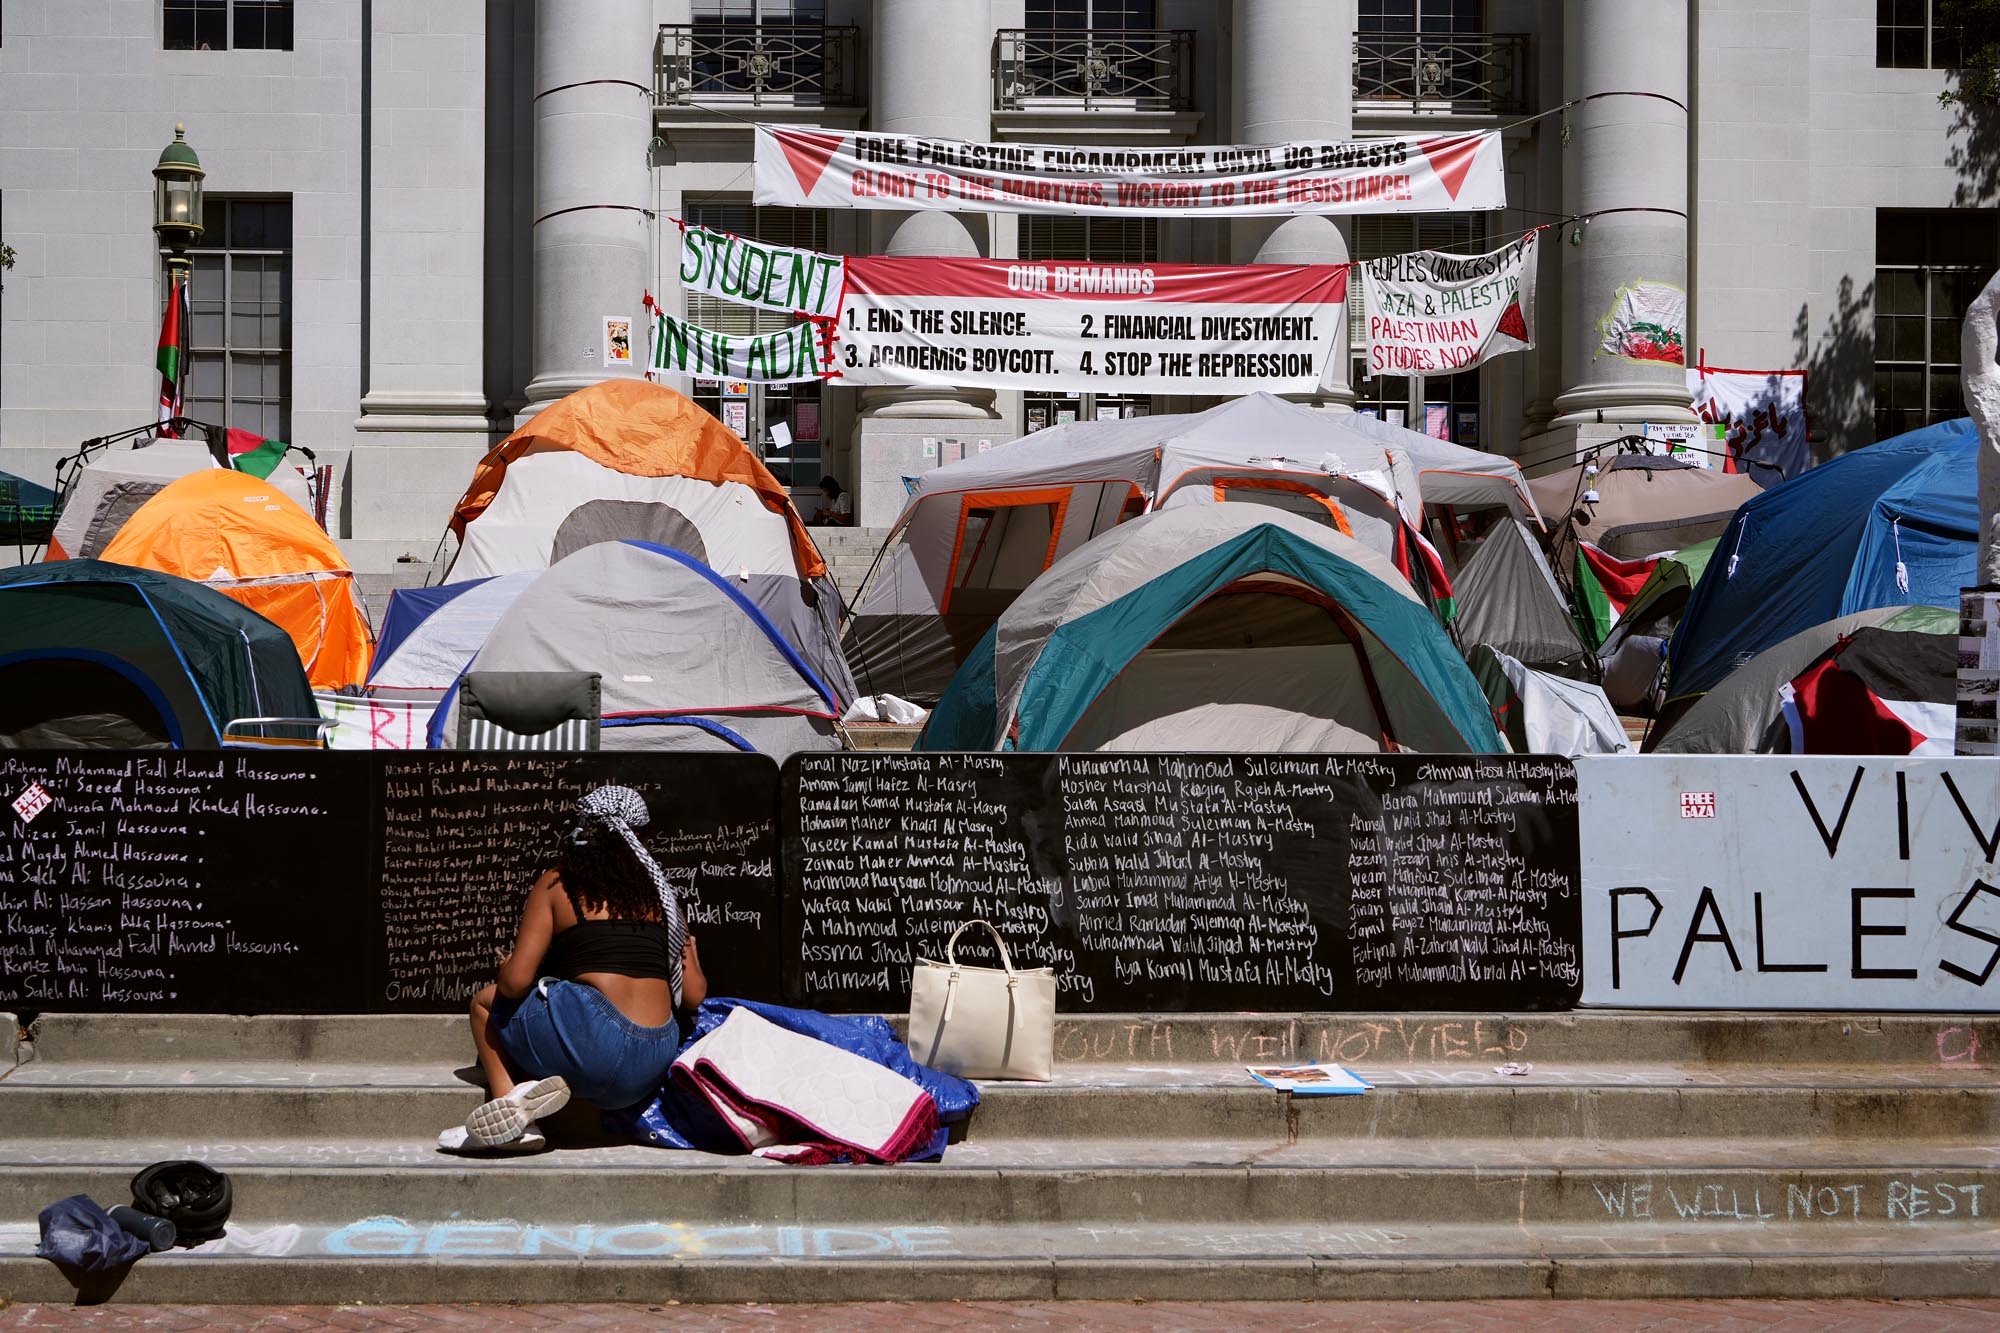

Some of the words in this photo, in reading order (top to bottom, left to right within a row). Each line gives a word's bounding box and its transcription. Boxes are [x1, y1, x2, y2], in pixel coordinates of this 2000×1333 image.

[854, 136, 908, 164] FREE
[917, 140, 1035, 172] PALESTINE
[1044, 150, 1206, 174] ENCAMPMENT
[1214, 151, 1276, 173] UNTIL
[1321, 141, 1407, 168] DIVESTS
[852, 170, 918, 198] GLORY
[926, 173, 950, 199] TO
[958, 176, 995, 201] THE
[1117, 182, 1203, 207] VICTORY
[1211, 181, 1235, 206] TO
[1243, 179, 1279, 204] THE
[1286, 175, 1413, 204] RESISTANCE!
[680, 229, 840, 315] STUDENT
[1431, 242, 1525, 283] UNIVERSITY
[1007, 265, 1047, 292] OUR
[1054, 267, 1154, 295] DEMANDS
[1424, 294, 1436, 316] &
[846, 308, 861, 332] 1.
[867, 308, 904, 332] END
[910, 310, 944, 334] THE
[950, 310, 1031, 336] SILENCE.
[1080, 314, 1098, 339] 2.
[1104, 314, 1195, 341] FINANCIAL
[1201, 317, 1318, 342] DIVESTMENT.
[1371, 316, 1479, 344] PALESTINIAN
[655, 316, 820, 380] INTIFADA
[845, 345, 862, 368] 3.
[869, 345, 967, 371] ACADEMIC
[973, 348, 1059, 374] BOYCOTT.
[1372, 345, 1435, 370] STUDIES
[1441, 345, 1482, 369] NOW
[1080, 351, 1098, 375] 4.
[1105, 352, 1152, 377] STOP
[1159, 353, 1191, 377] THE
[1199, 353, 1319, 378] REPRESSION.
[1681, 793, 1714, 805] FREE
[1682, 806, 1715, 818] GAZA
[1608, 879, 2000, 990] PALES
[1054, 1020, 1174, 1063] OUTH
[1320, 1019, 1390, 1062] NOT
[1592, 1180, 1653, 1220] WE
[1666, 1183, 1775, 1222] WILL
[1788, 1183, 1864, 1221] NOT
[1887, 1180, 1985, 1221] REST
[324, 1217, 963, 1257] GENOCIDE
